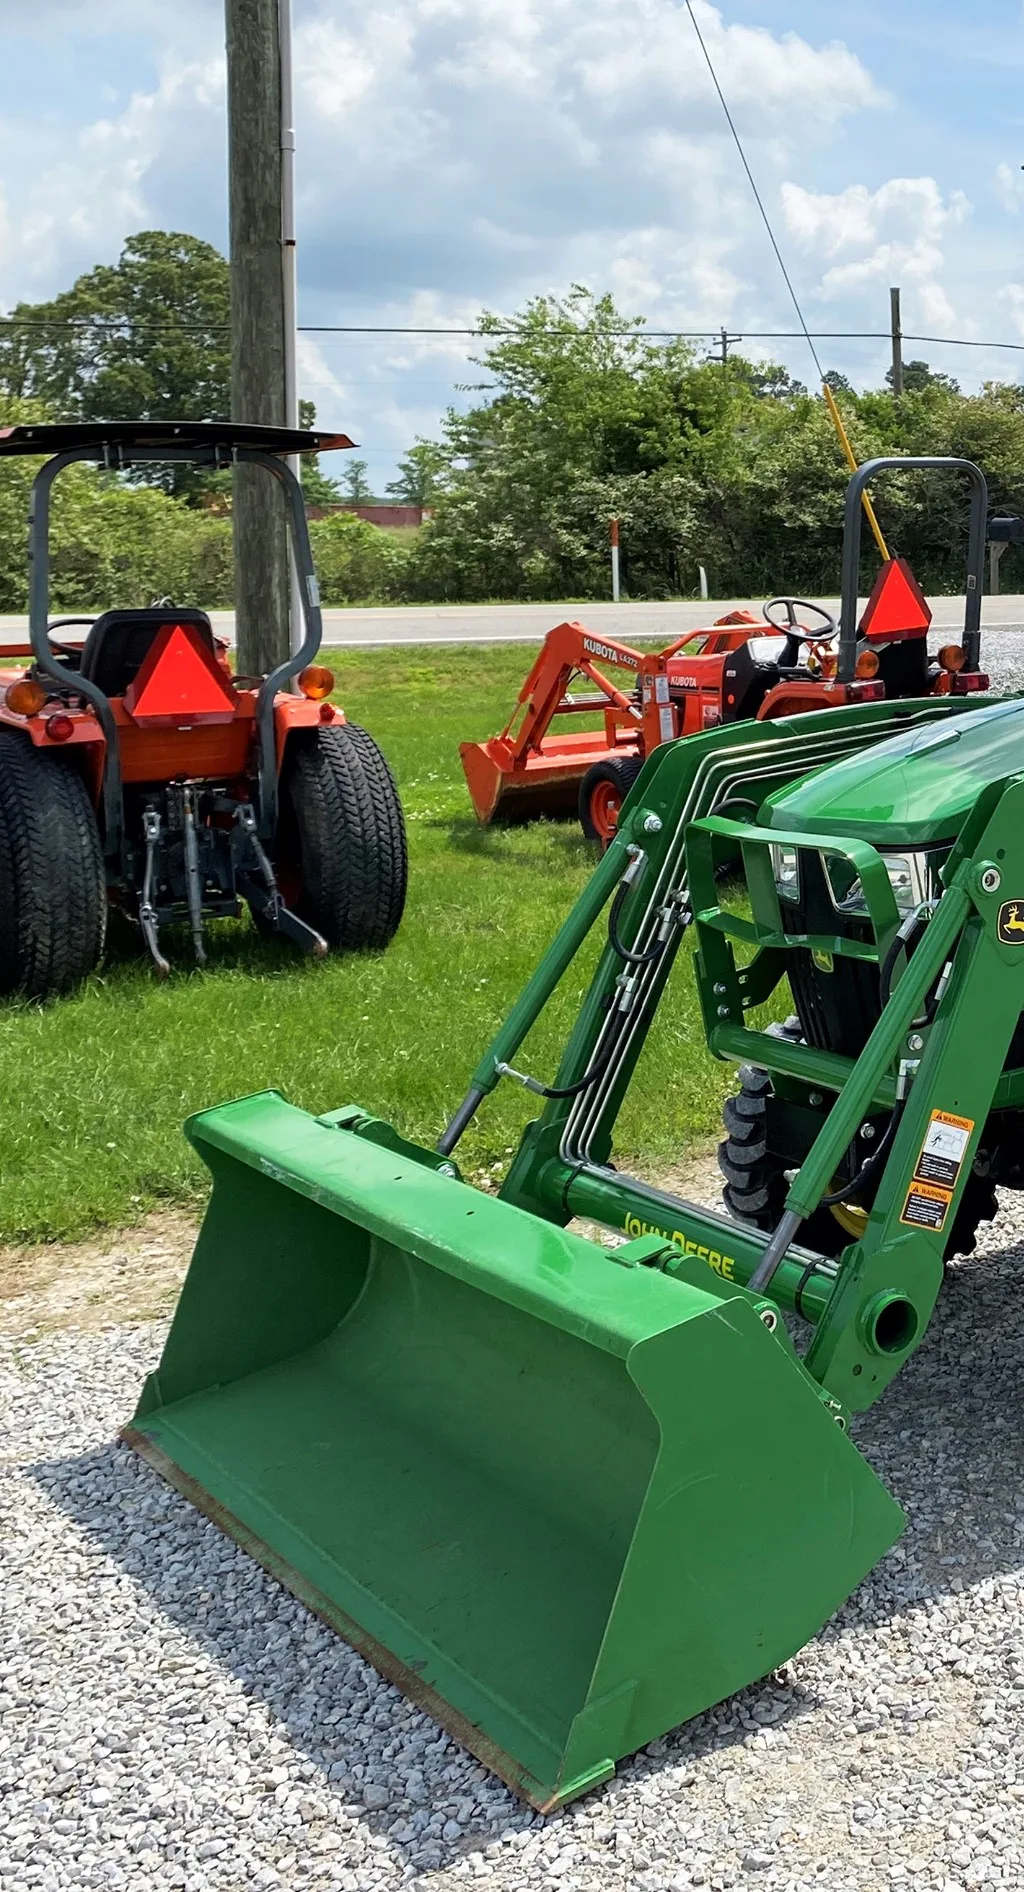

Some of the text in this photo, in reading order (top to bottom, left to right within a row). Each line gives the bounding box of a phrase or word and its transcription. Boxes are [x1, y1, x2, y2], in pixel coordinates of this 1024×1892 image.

[583, 637, 618, 663] KUBOTA
[670, 675, 697, 687] KUBOTA
[942, 1114, 969, 1128] WARNING
[920, 1189, 947, 1200] WARNING
